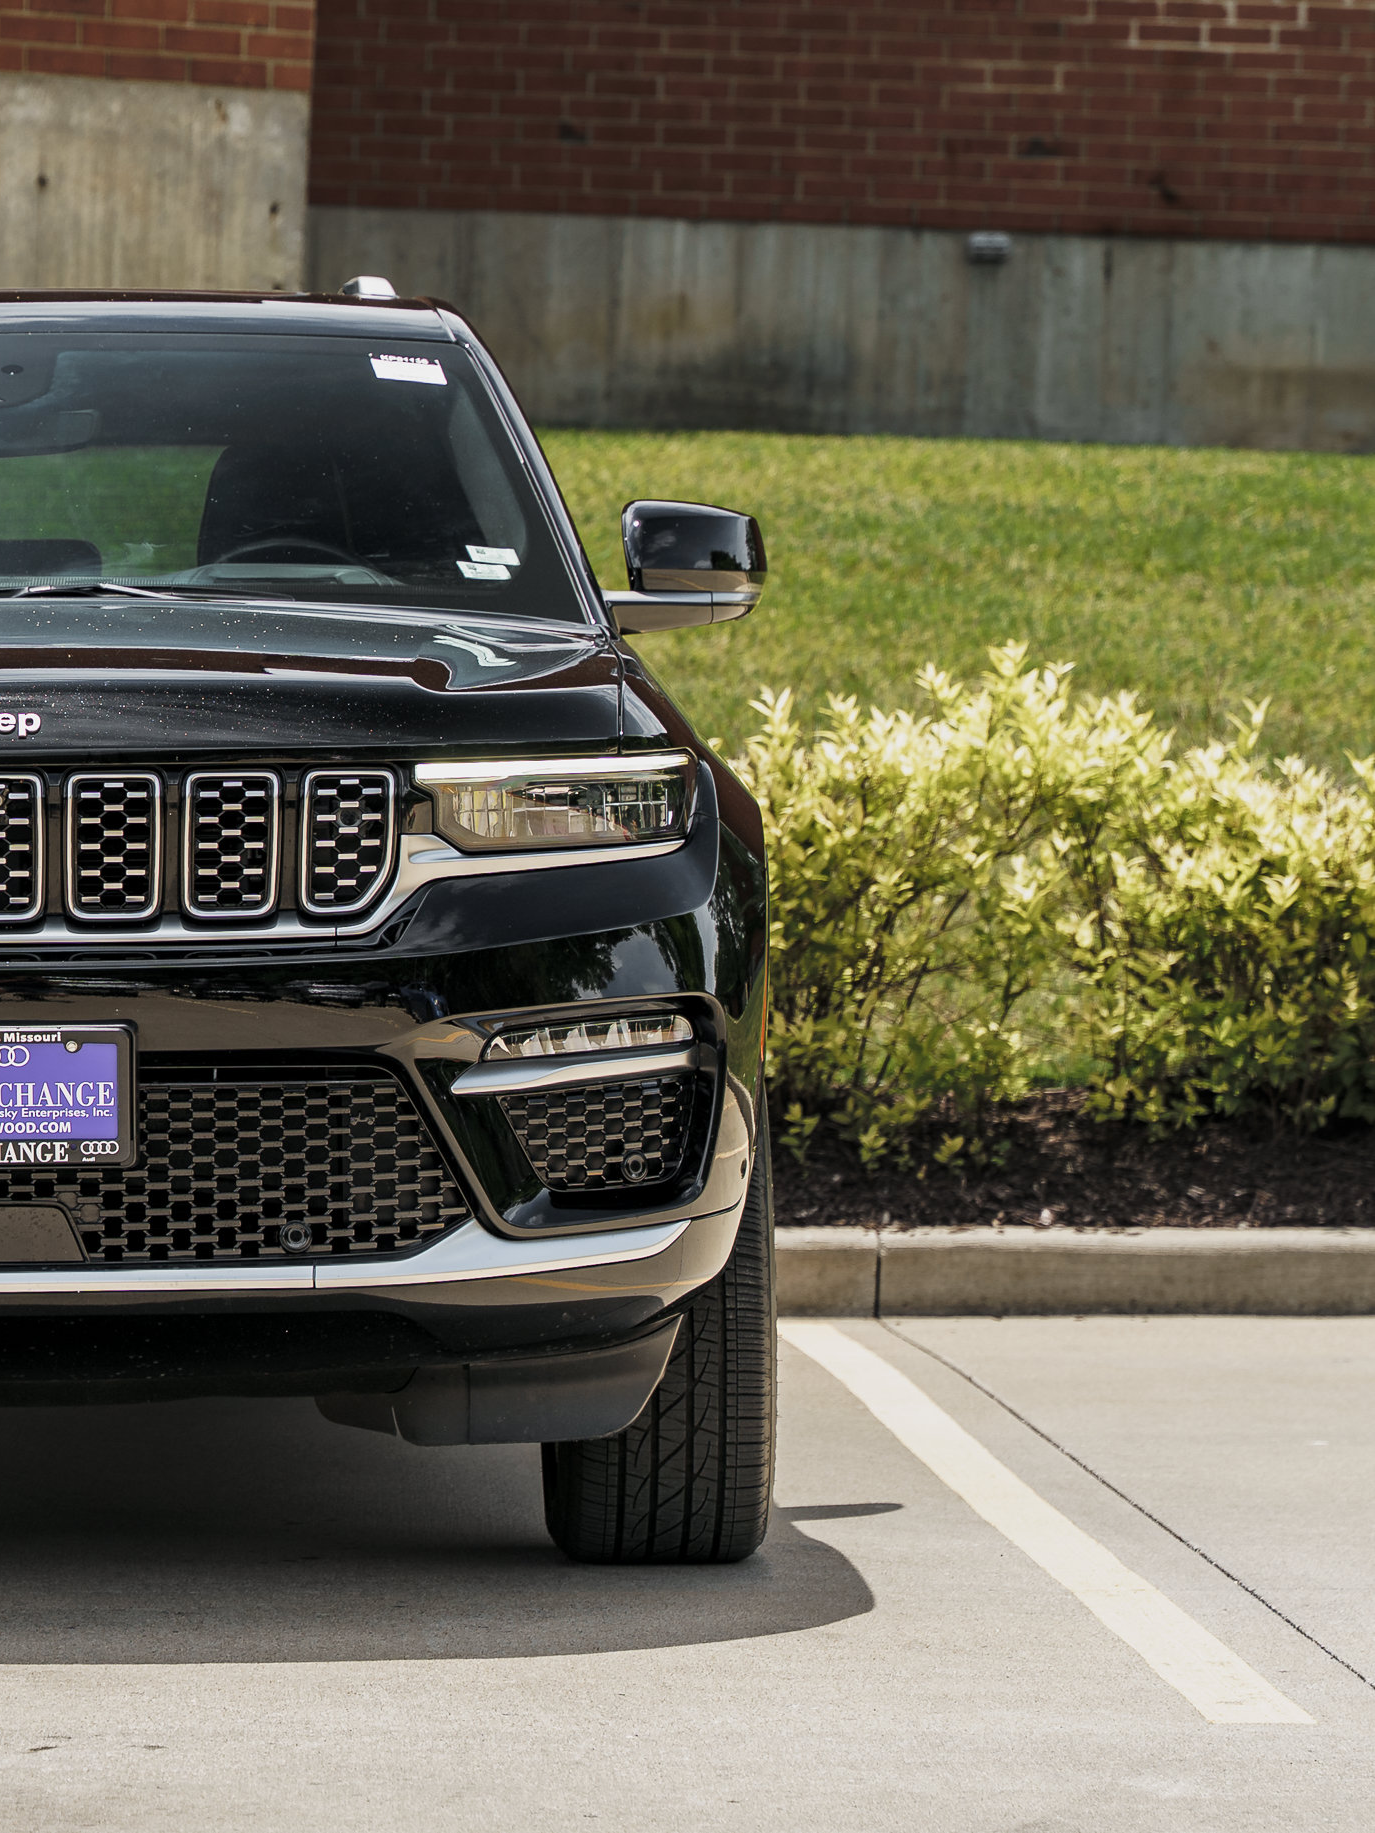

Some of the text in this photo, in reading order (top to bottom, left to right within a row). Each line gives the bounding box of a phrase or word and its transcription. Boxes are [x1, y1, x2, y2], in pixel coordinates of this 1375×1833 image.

[3, 1032, 62, 1043] Missouri
[21, 1107, 90, 1120] Enterprises,
[92, 1106, 113, 1117] Inc.
